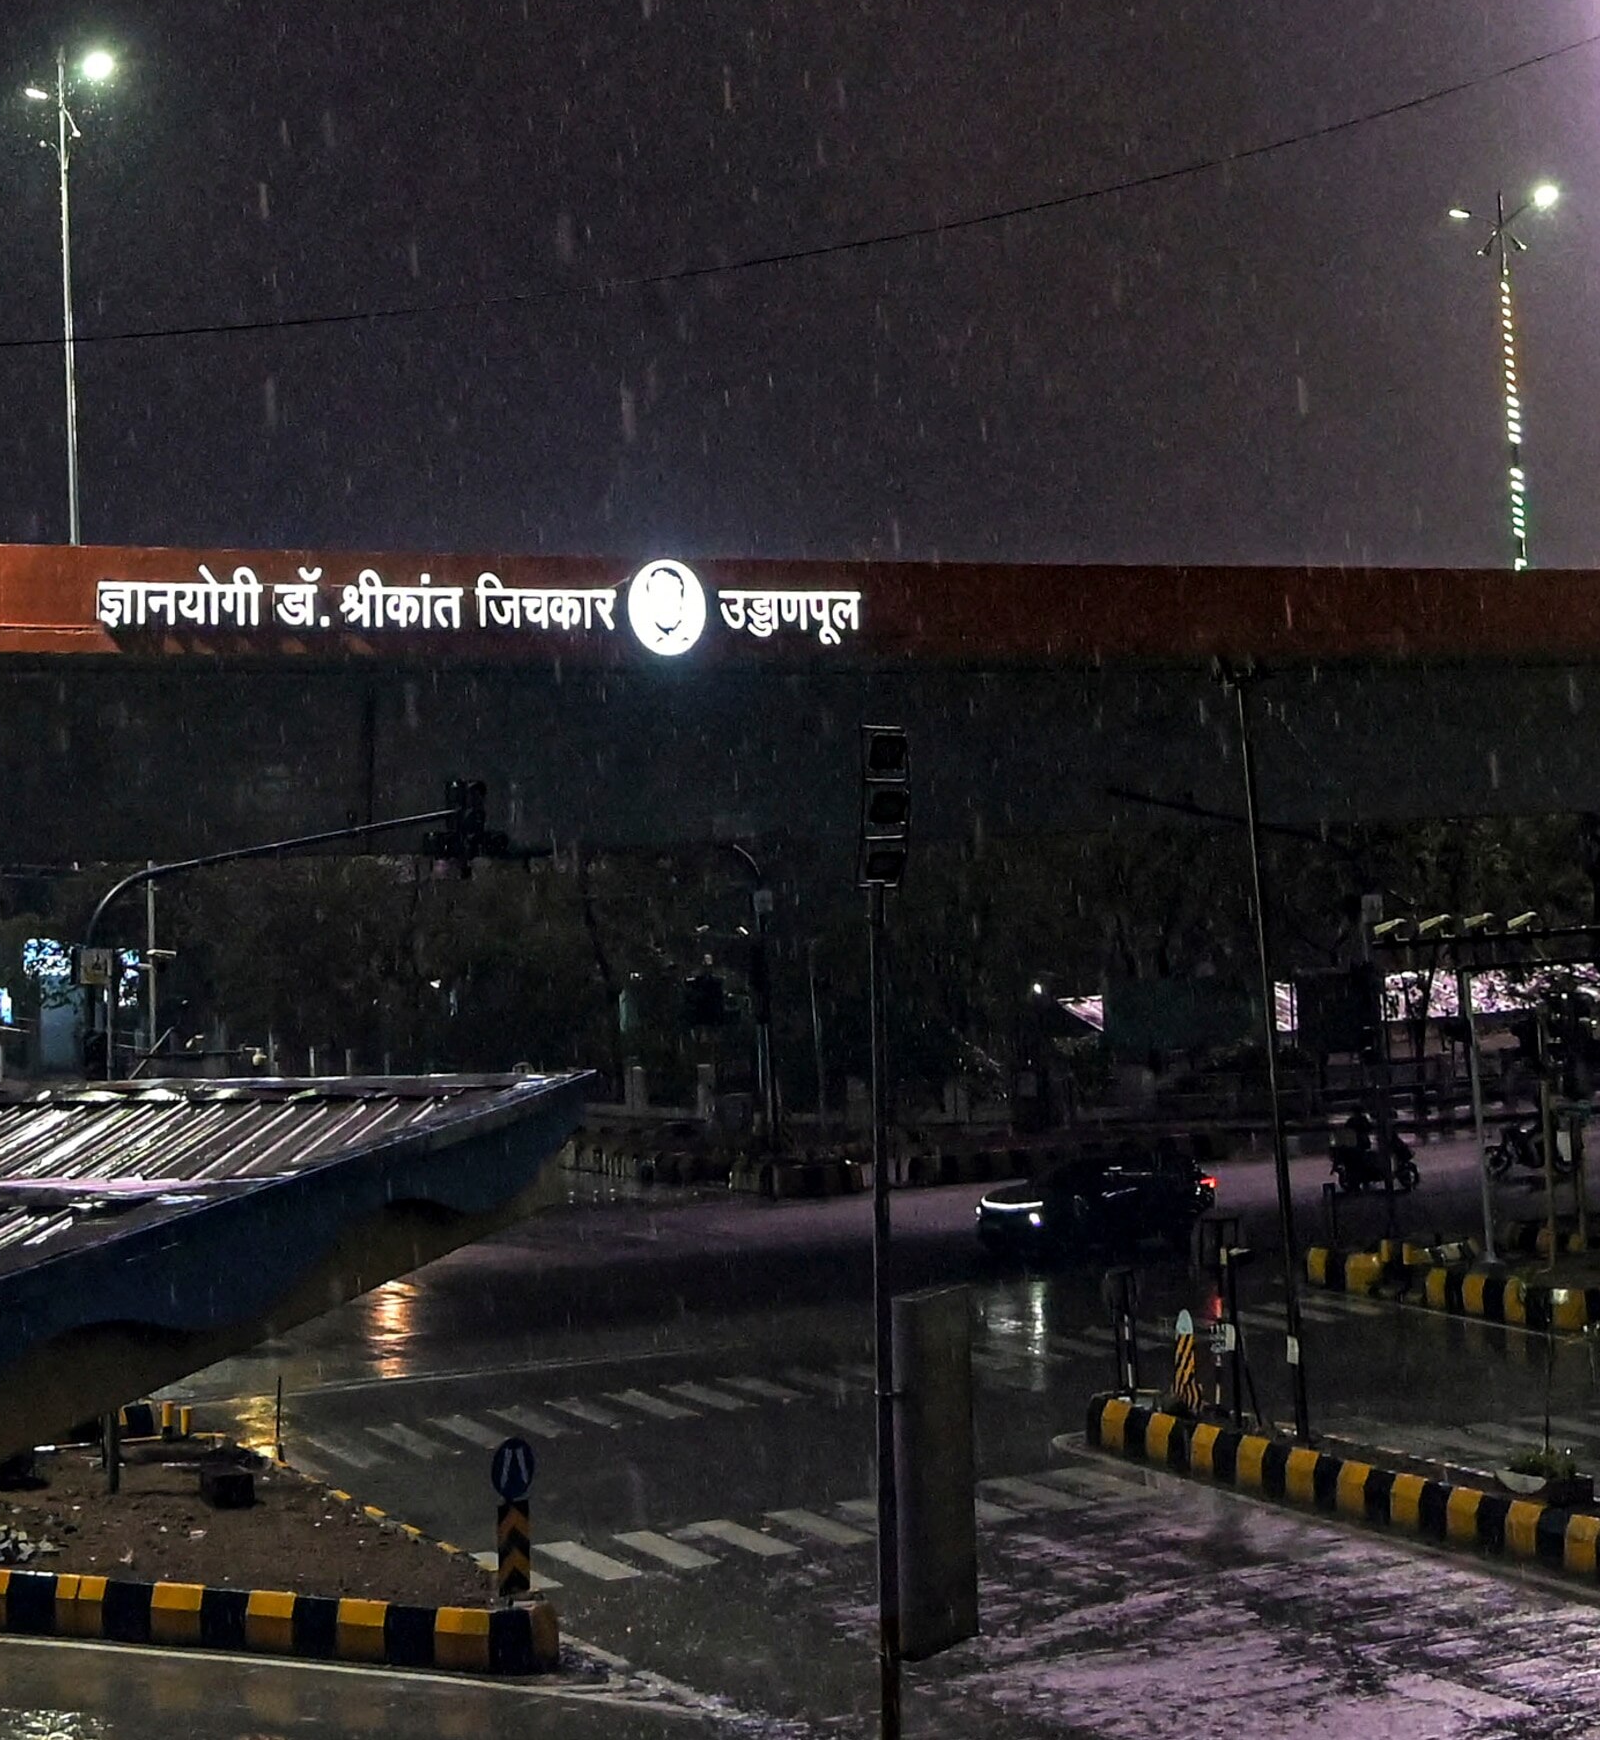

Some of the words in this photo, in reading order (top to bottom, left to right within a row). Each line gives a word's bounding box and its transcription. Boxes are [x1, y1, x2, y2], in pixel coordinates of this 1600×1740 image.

[96, 565, 263, 627] ज्ञानयोगी
[273, 567, 330, 627] डॉ.
[340, 569, 463, 628] श्रीकांत
[475, 573, 617, 630] जिचकार
[718, 590, 861, 644] उड्डाणपूल
